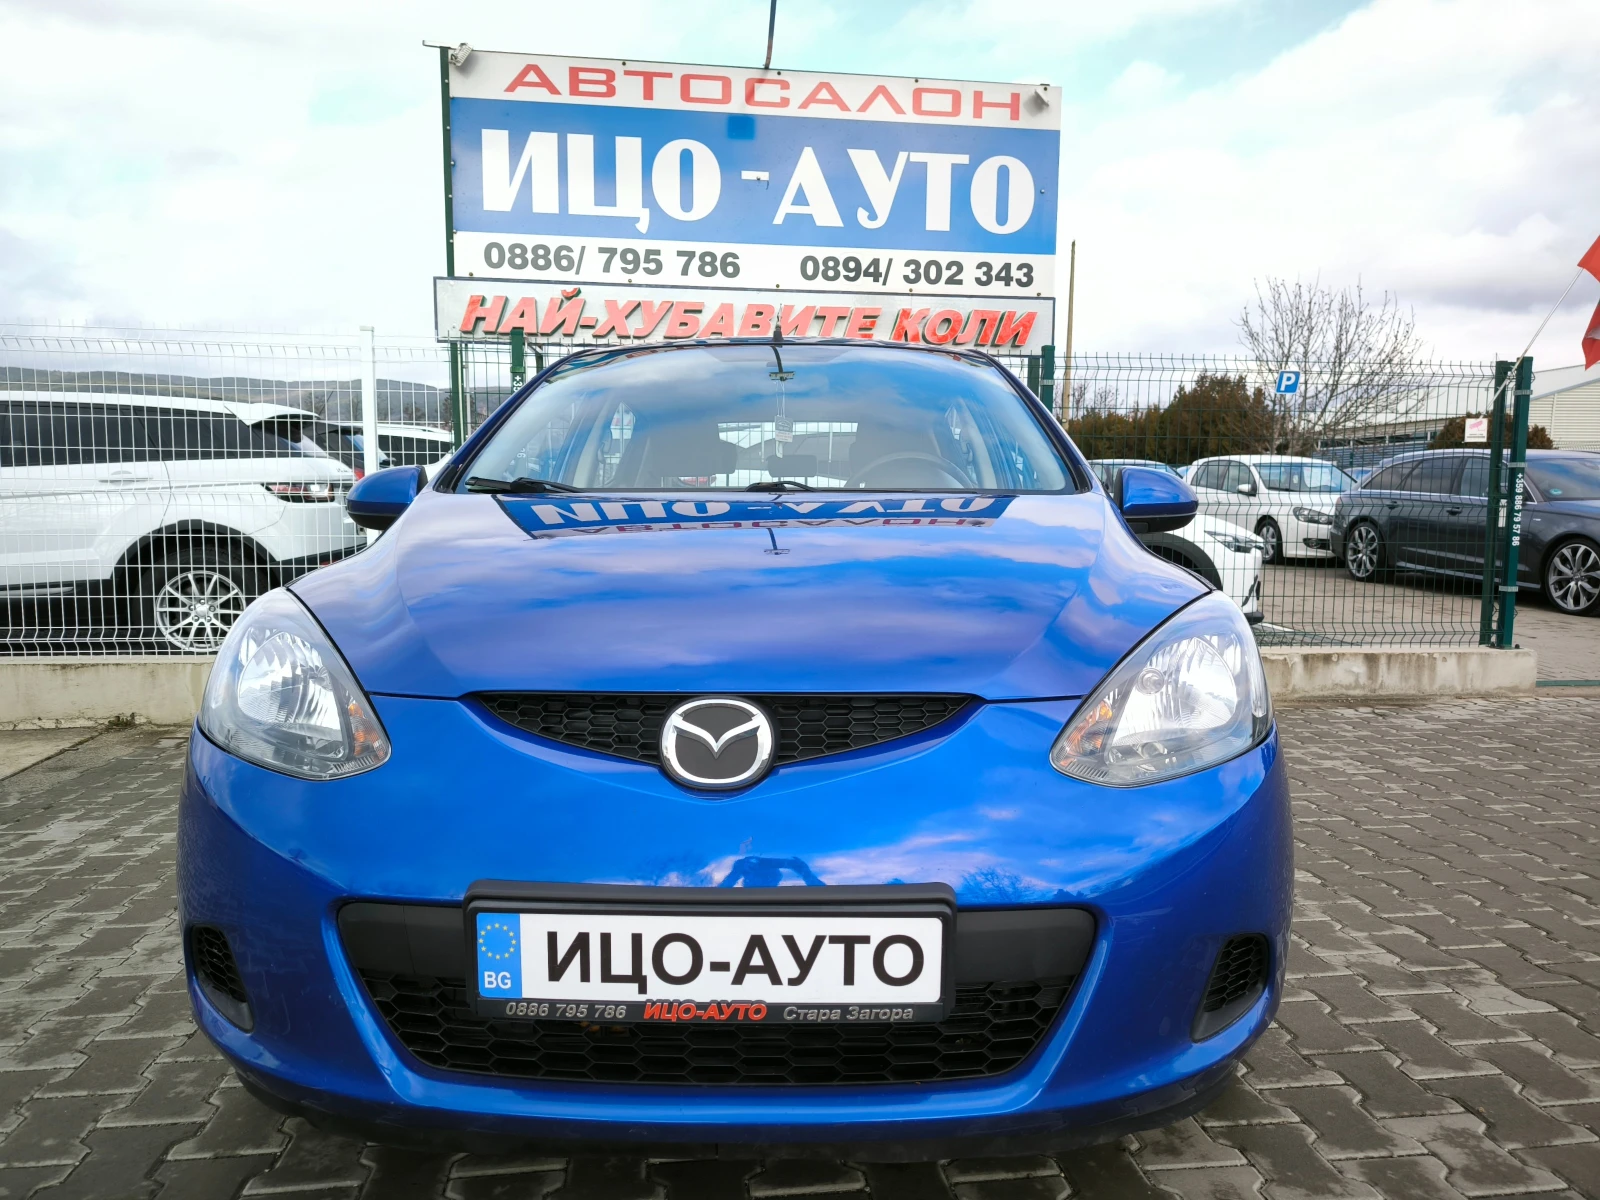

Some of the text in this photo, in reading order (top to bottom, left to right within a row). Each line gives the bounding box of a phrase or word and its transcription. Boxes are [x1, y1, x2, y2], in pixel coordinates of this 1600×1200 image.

[503, 64, 1021, 121] АВТОСАЛОН
[483, 242, 741, 279] 0886/ 795 786
[800, 255, 1034, 288] 0894/ 302 343
[459, 286, 1038, 346] НАЙ-ХУБАВИТЕ КОЛИ
[1280, 372, 1296, 391] P
[1514, 495, 1523, 510] 886
[1512, 536, 1520, 546] 86
[546, 930, 925, 995] ИЦО-АУТО
[484, 971, 512, 989] BG
[505, 1001, 914, 1022] 0886 795 786 ИЦО-АУТО Стара Загора
